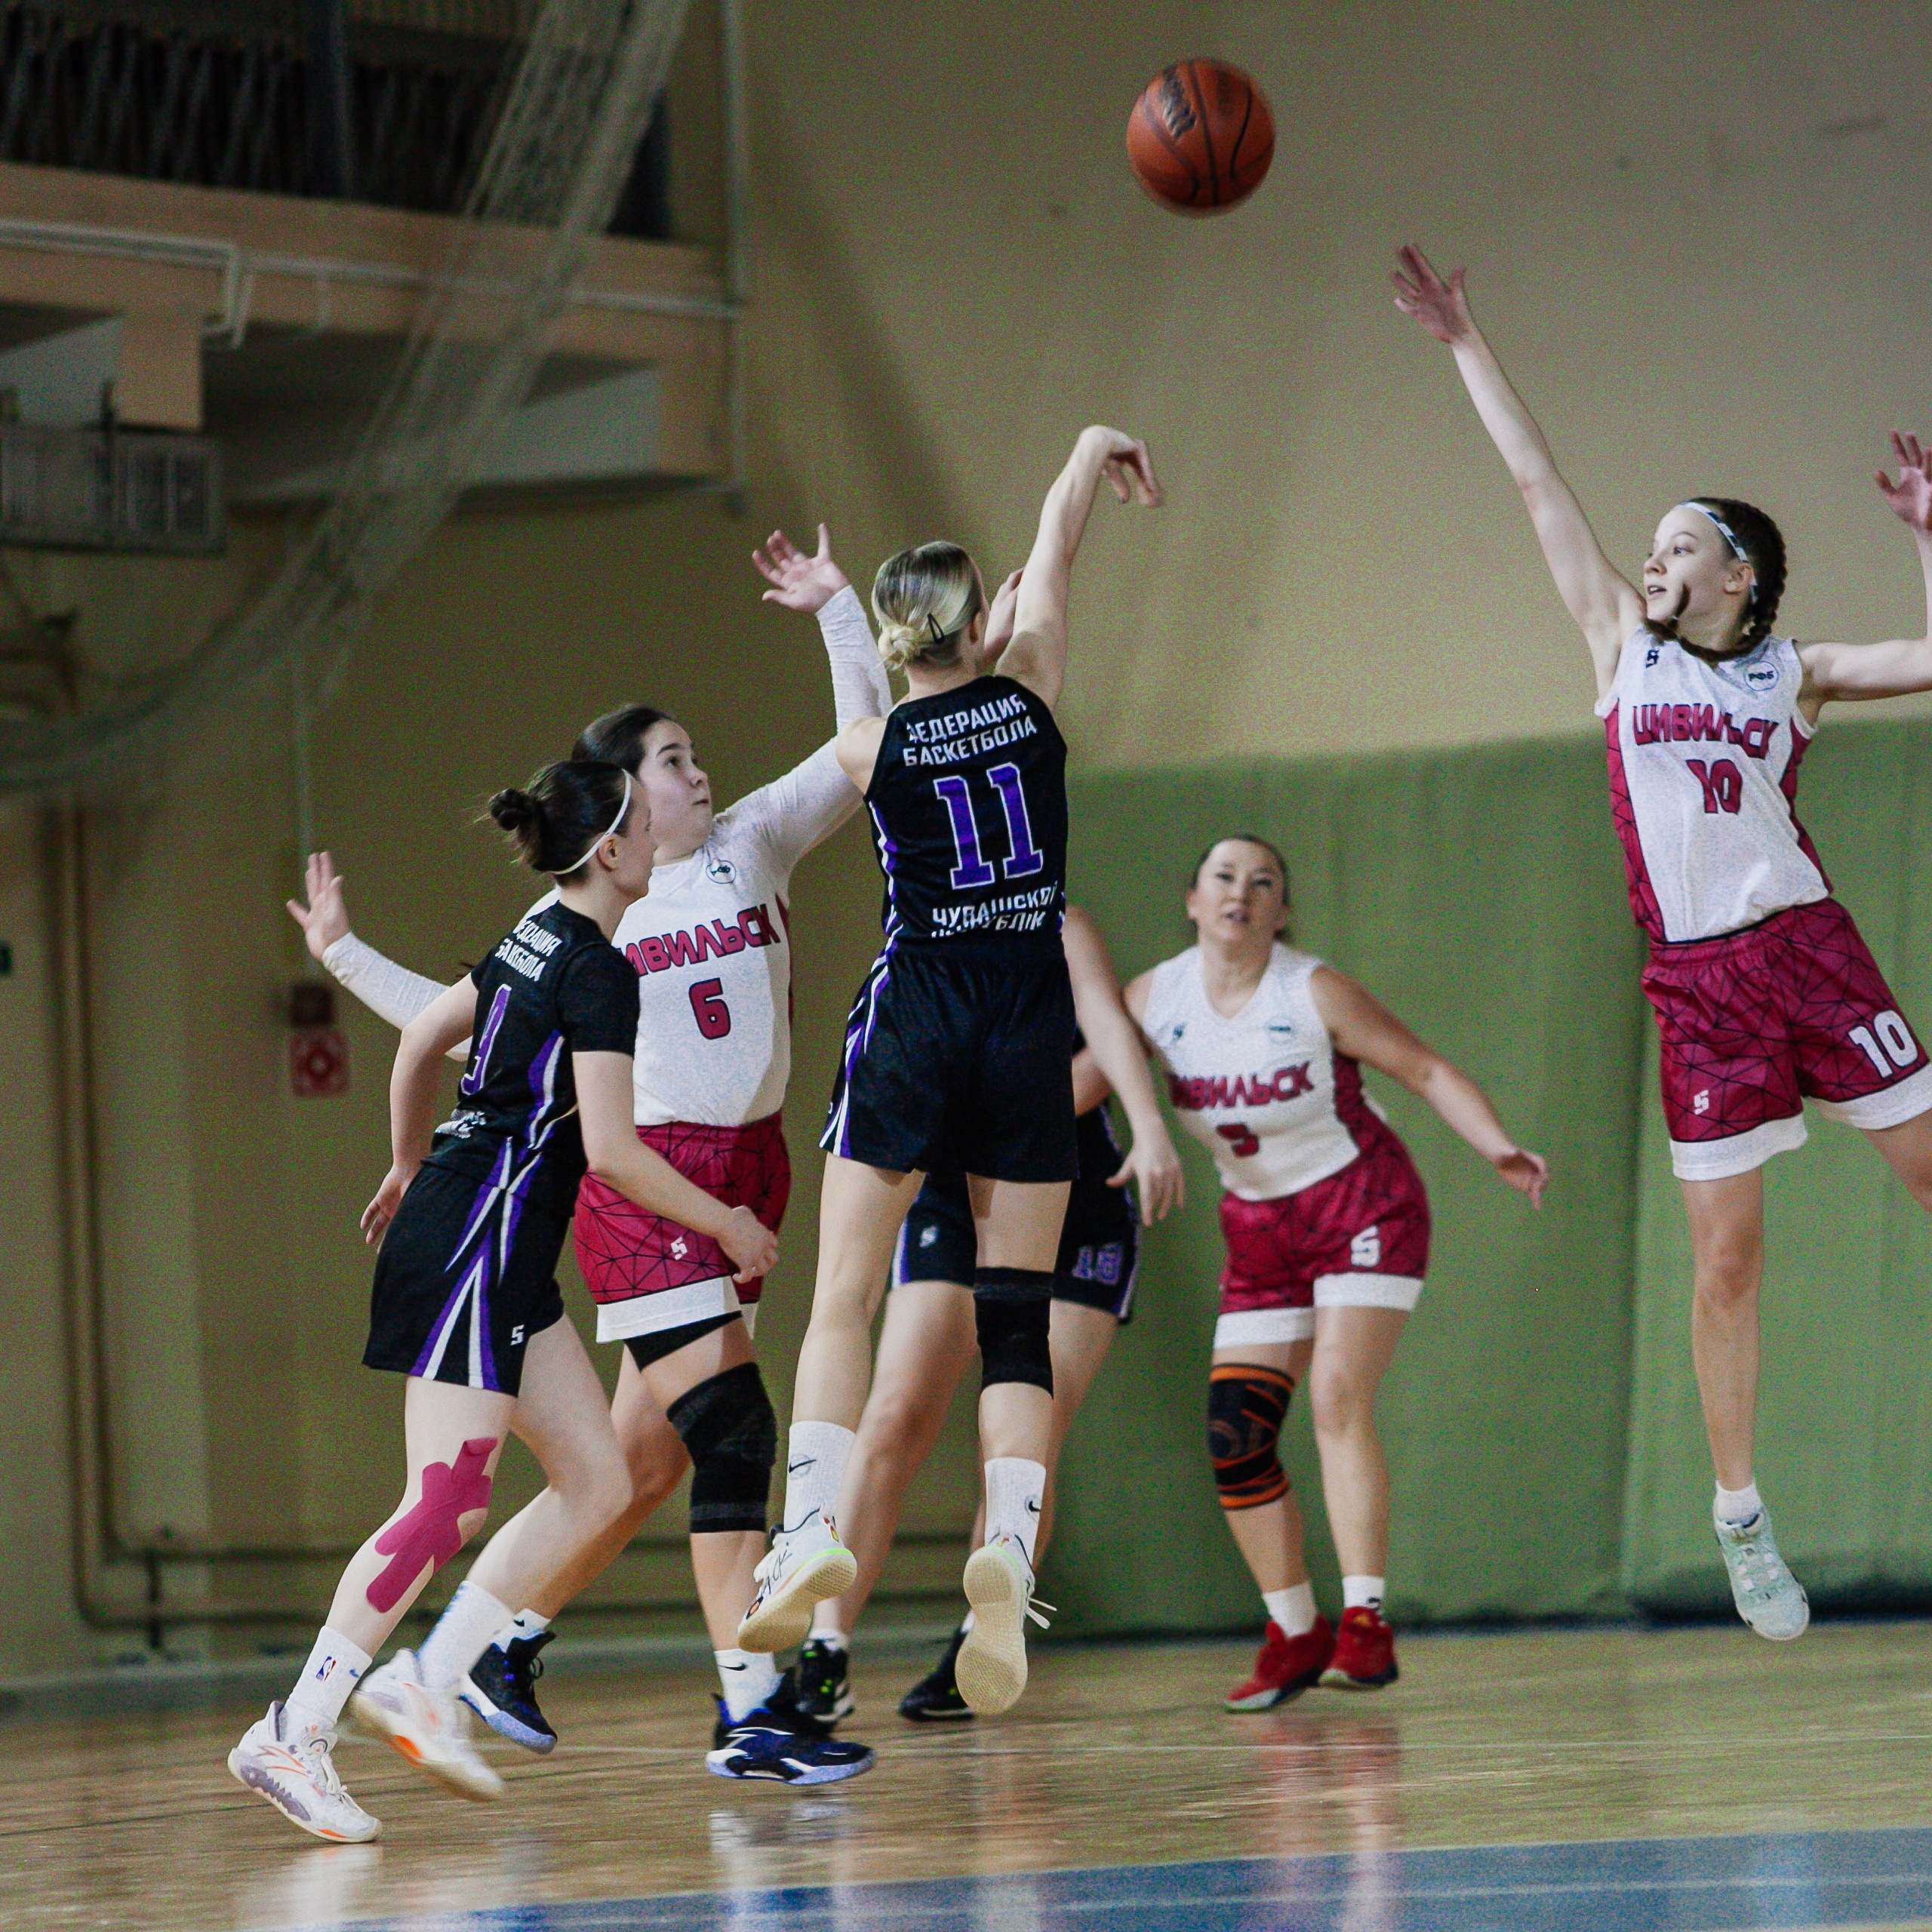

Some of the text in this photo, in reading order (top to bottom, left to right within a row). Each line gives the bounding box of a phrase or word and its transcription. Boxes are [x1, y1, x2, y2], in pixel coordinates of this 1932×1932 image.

[903, 716, 1037, 766] БАСКЕТБОЛА
[1686, 758, 1742, 814] 10
[934, 762, 1043, 890] 11
[618, 904, 780, 977] ИВИЛЬСК
[688, 977, 731, 1040] 6
[1848, 1010, 1918, 1078] 10
